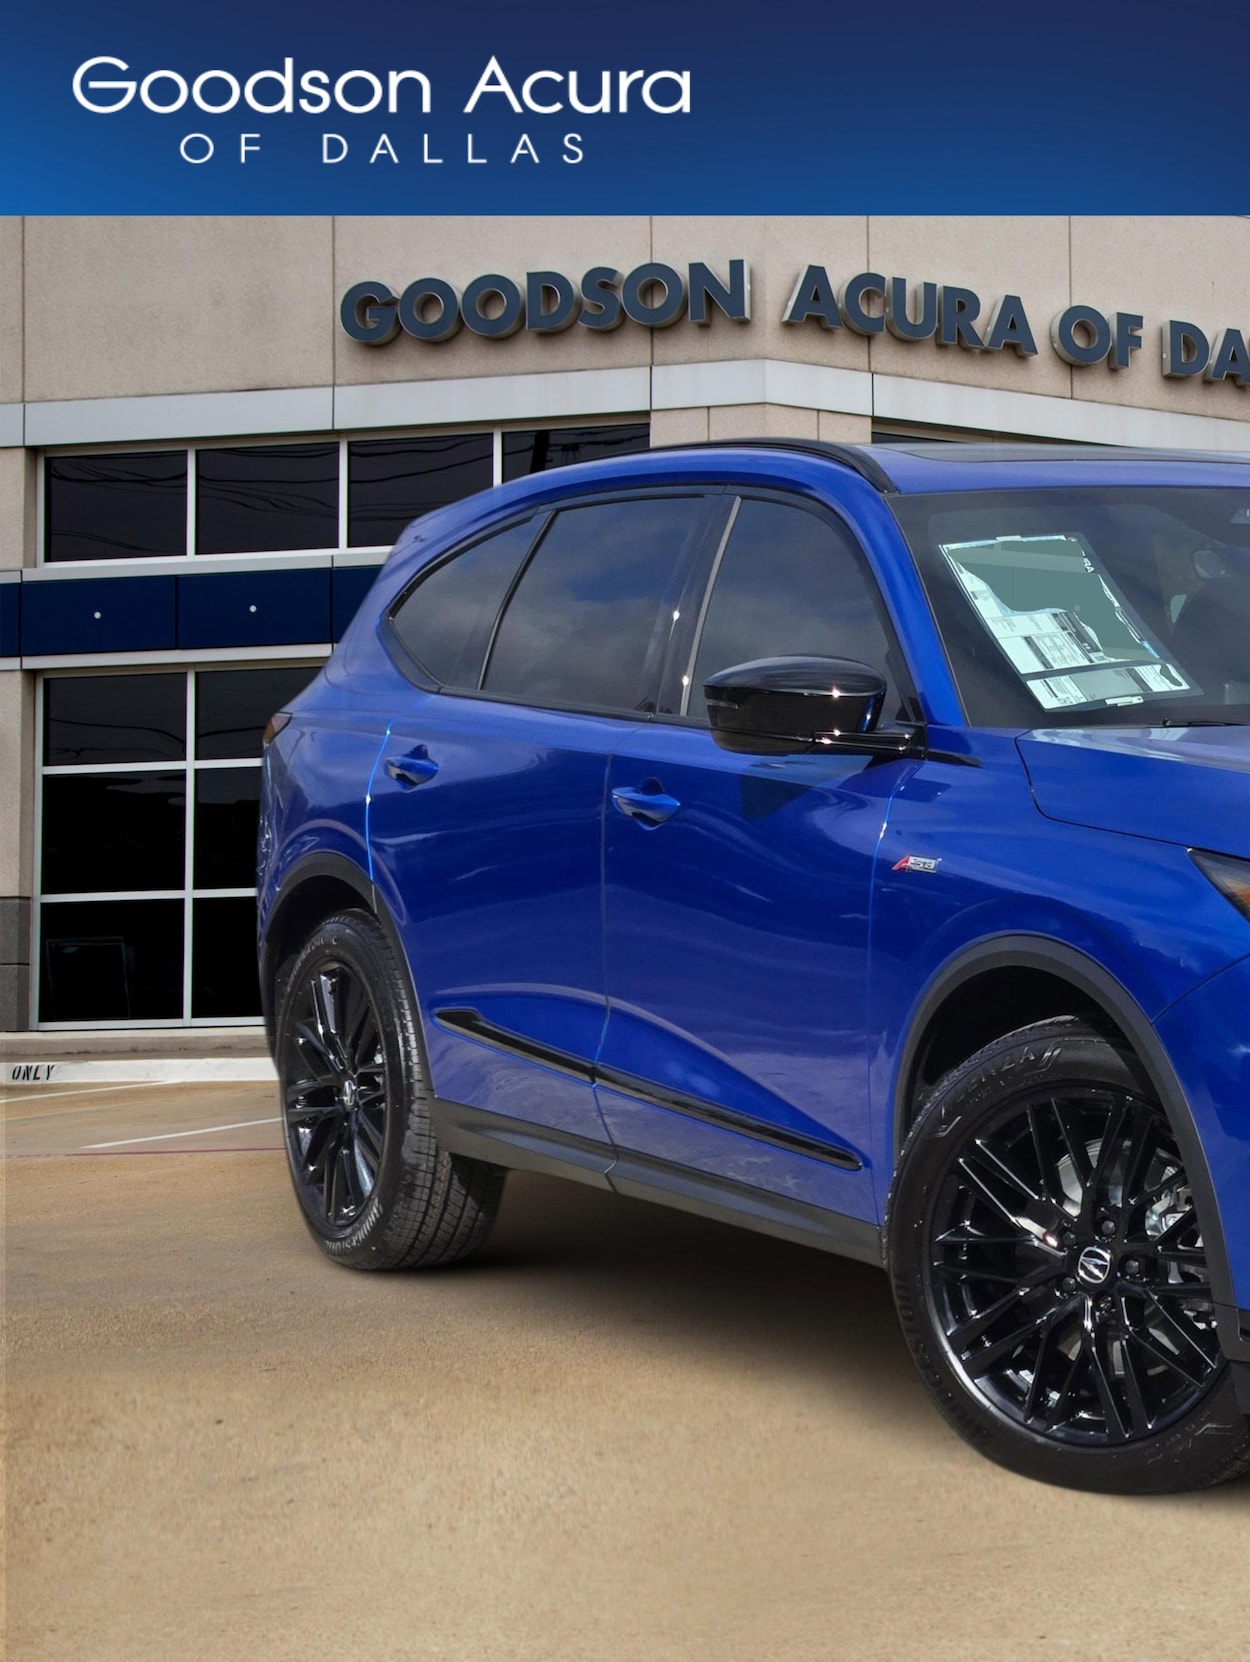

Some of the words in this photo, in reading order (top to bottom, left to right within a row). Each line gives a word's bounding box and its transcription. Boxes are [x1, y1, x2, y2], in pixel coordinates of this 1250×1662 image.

[340, 258, 751, 348] GOODSON
[782, 265, 1038, 357] ACURA
[1050, 304, 1144, 370] OF
[11, 1064, 55, 1081] ONLY
